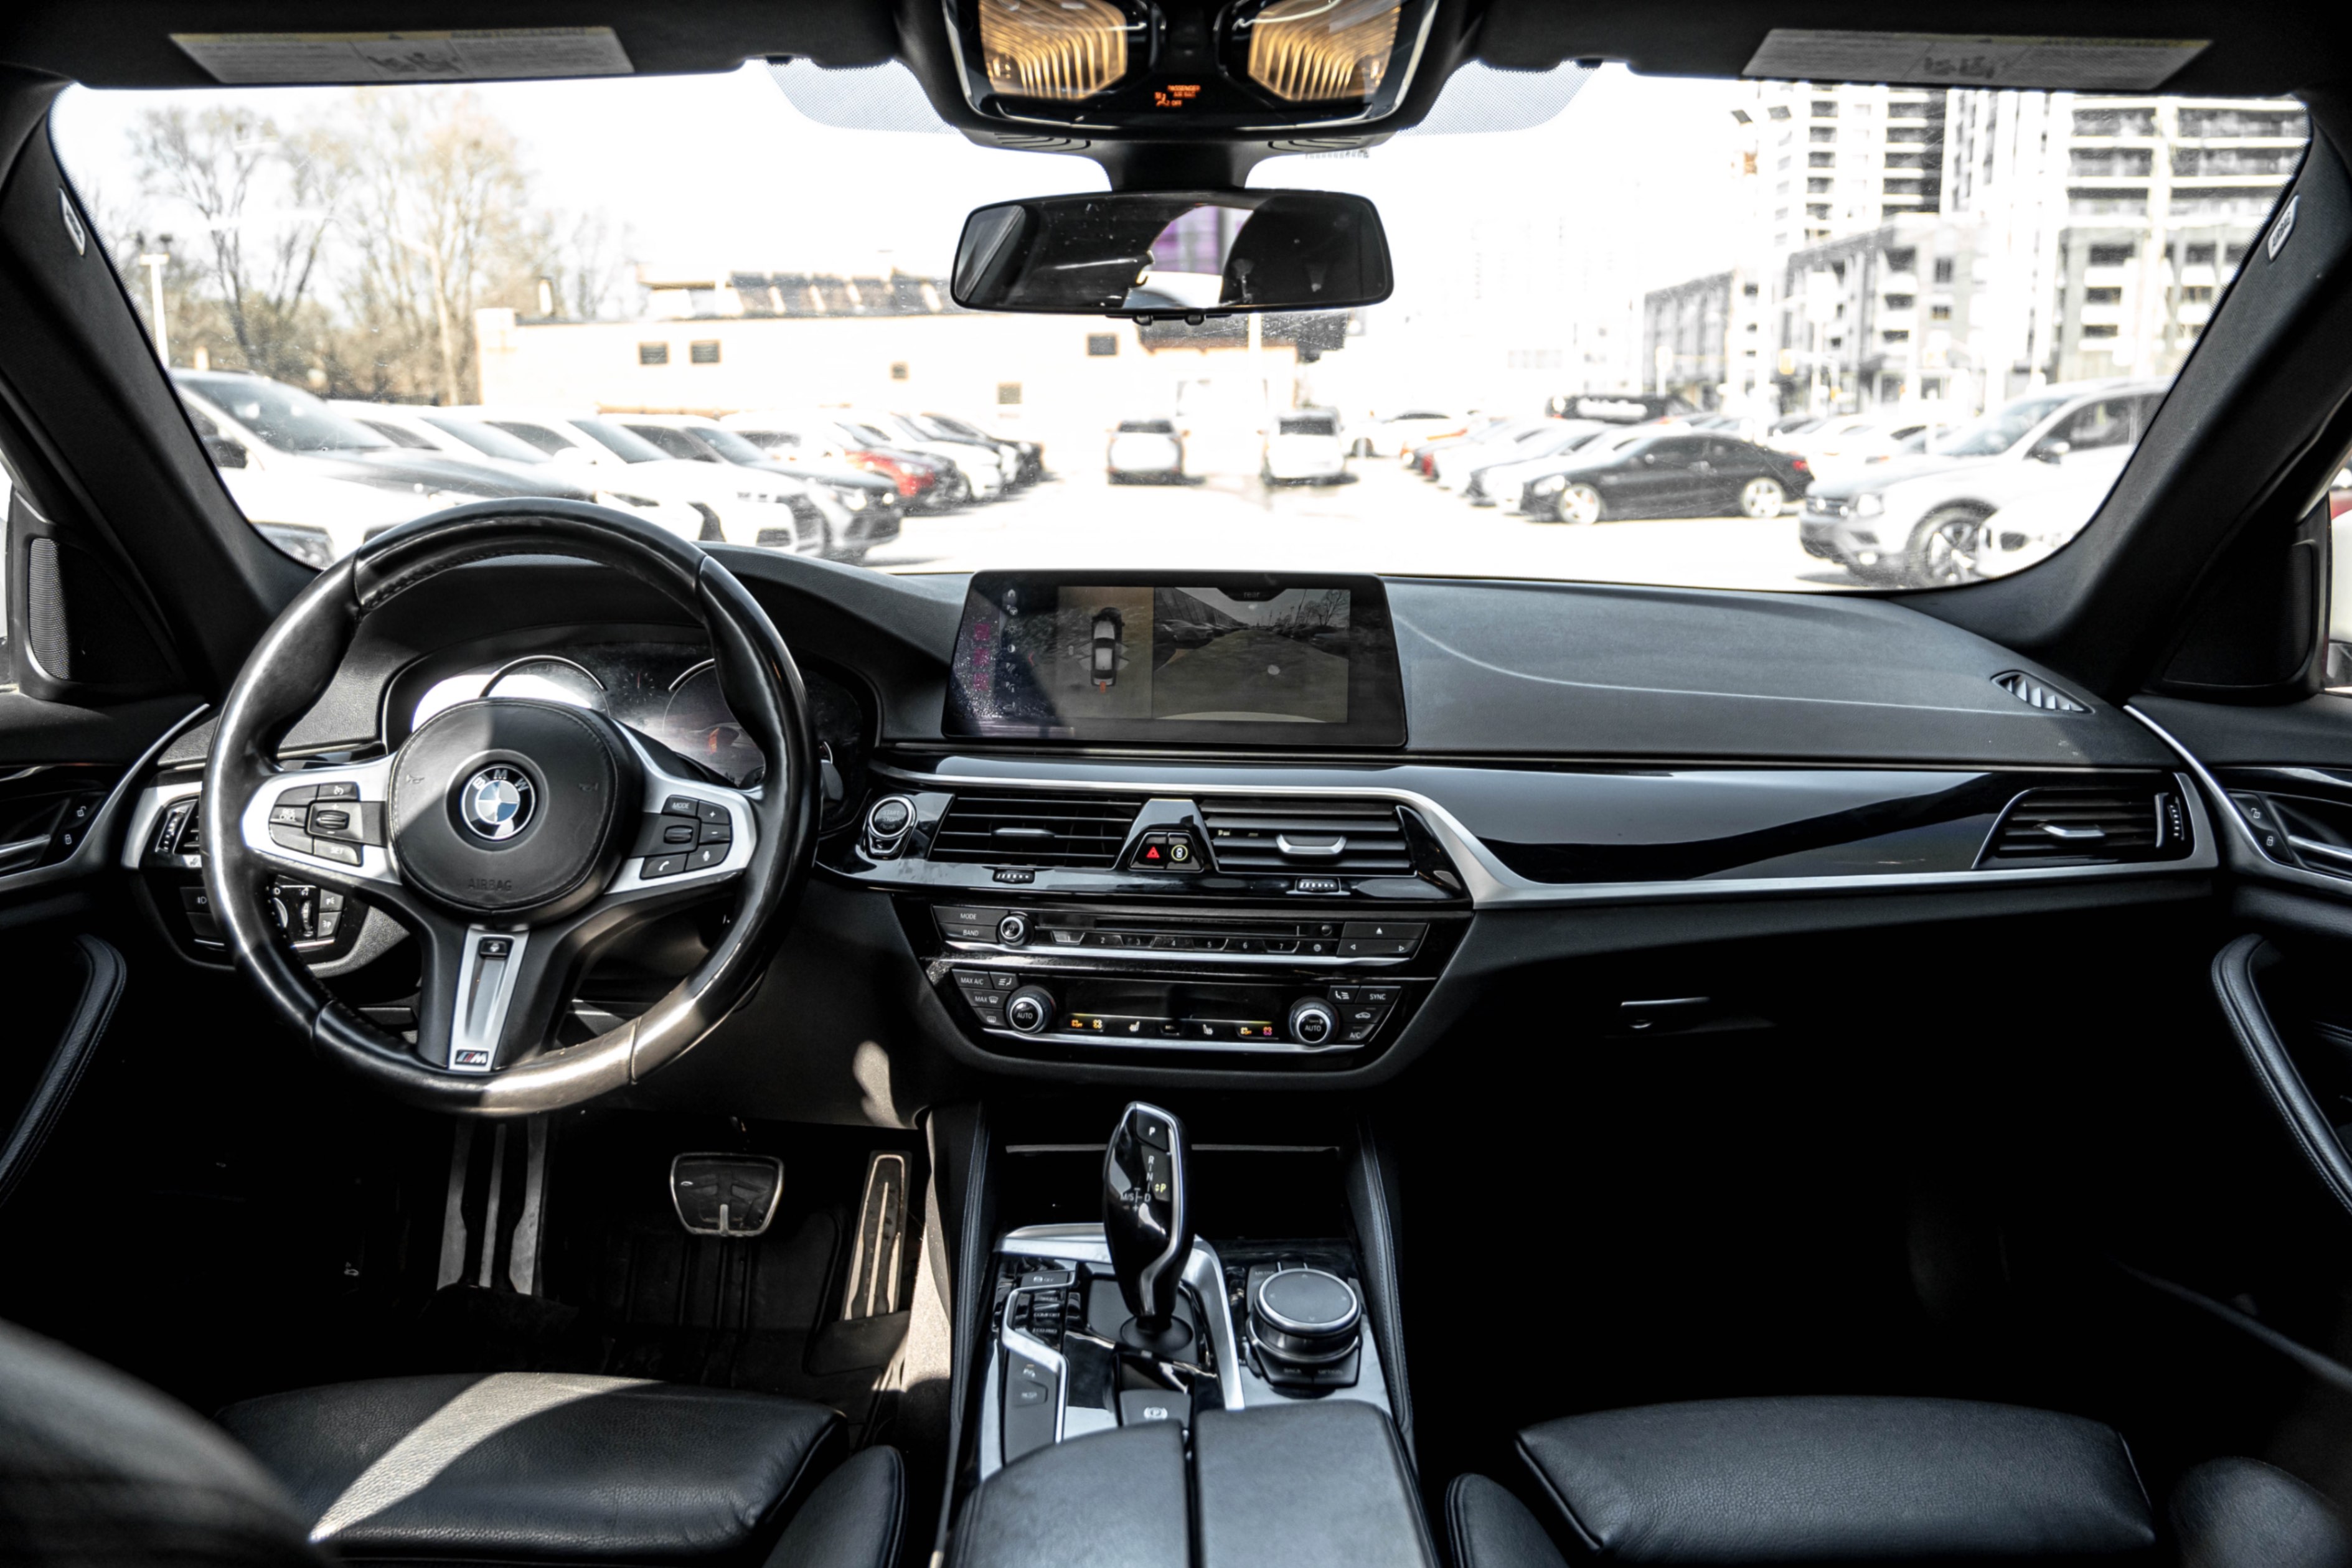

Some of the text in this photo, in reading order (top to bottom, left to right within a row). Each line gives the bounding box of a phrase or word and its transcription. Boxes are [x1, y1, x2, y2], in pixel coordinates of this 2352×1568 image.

[472, 769, 530, 791] BMW
[330, 847, 345, 855] SET
[468, 878, 512, 891] AIRBAG
[1149, 1127, 1155, 1136] P
[1148, 1155, 1155, 1165] R
[1146, 1172, 1154, 1181] N
[1160, 1183, 1167, 1193] P
[1120, 1193, 1151, 1202] M/S D
